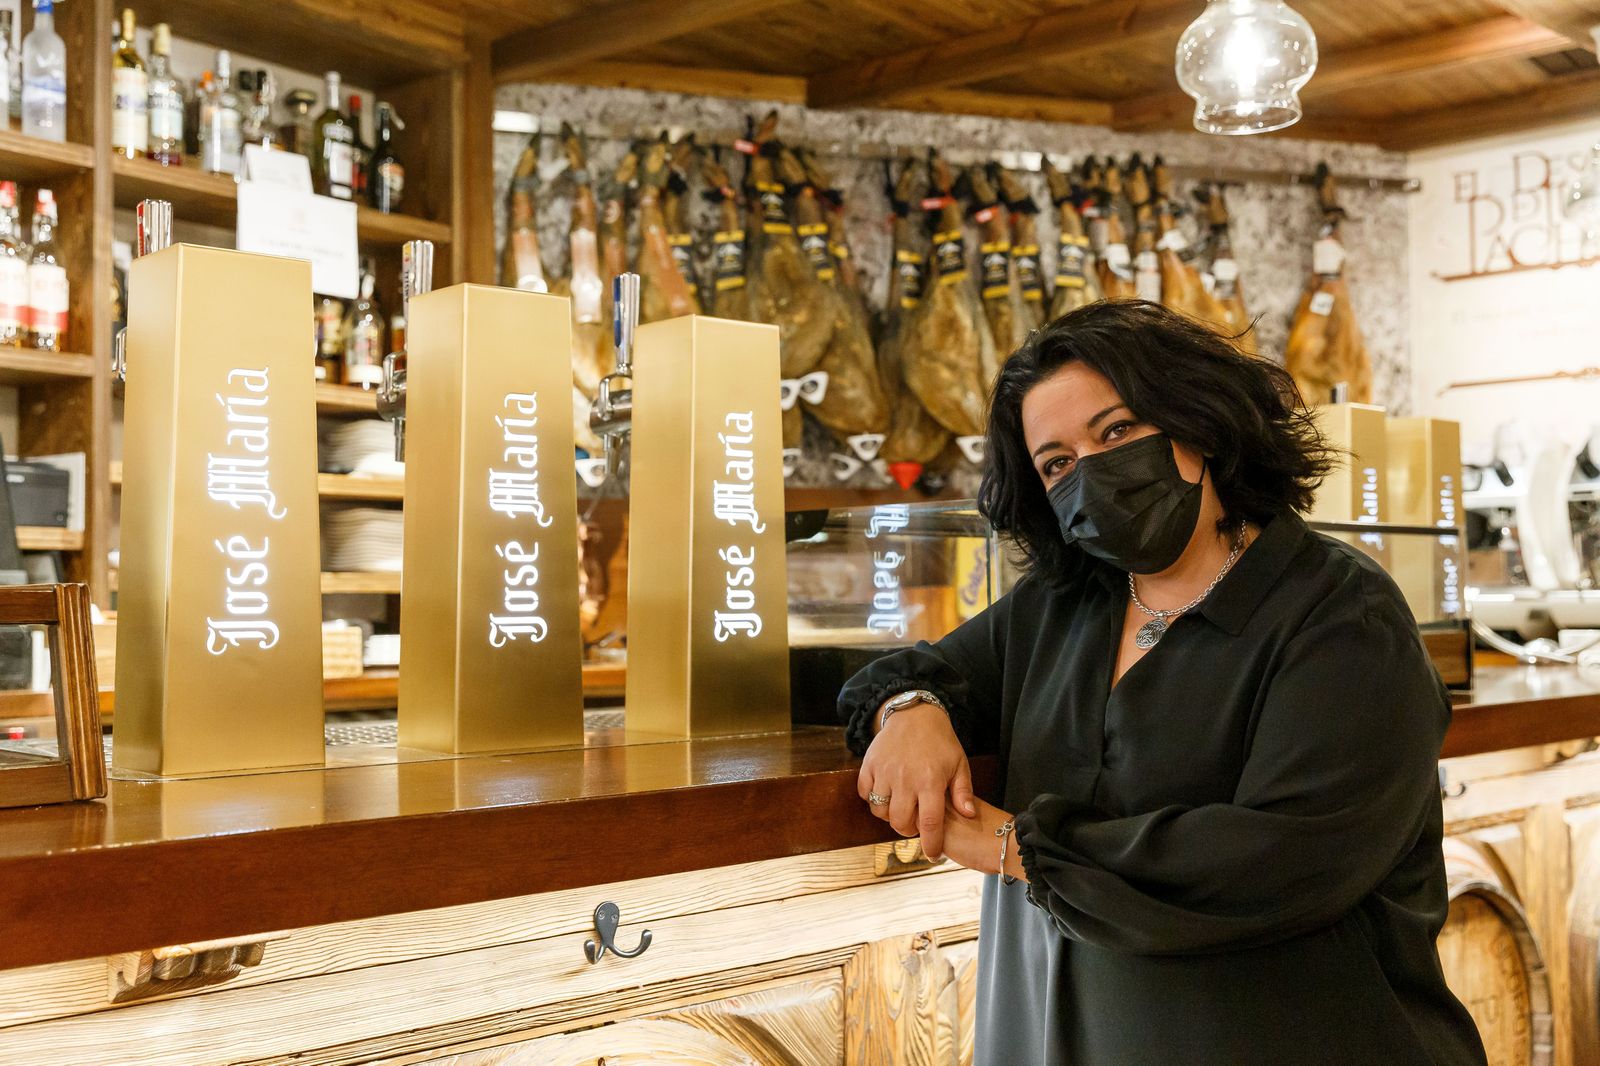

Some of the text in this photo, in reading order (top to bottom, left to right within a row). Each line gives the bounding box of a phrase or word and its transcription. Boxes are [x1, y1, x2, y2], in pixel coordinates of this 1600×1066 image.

[206, 366, 288, 656] José María
[488, 391, 553, 648] José María
[713, 410, 766, 643] José María
